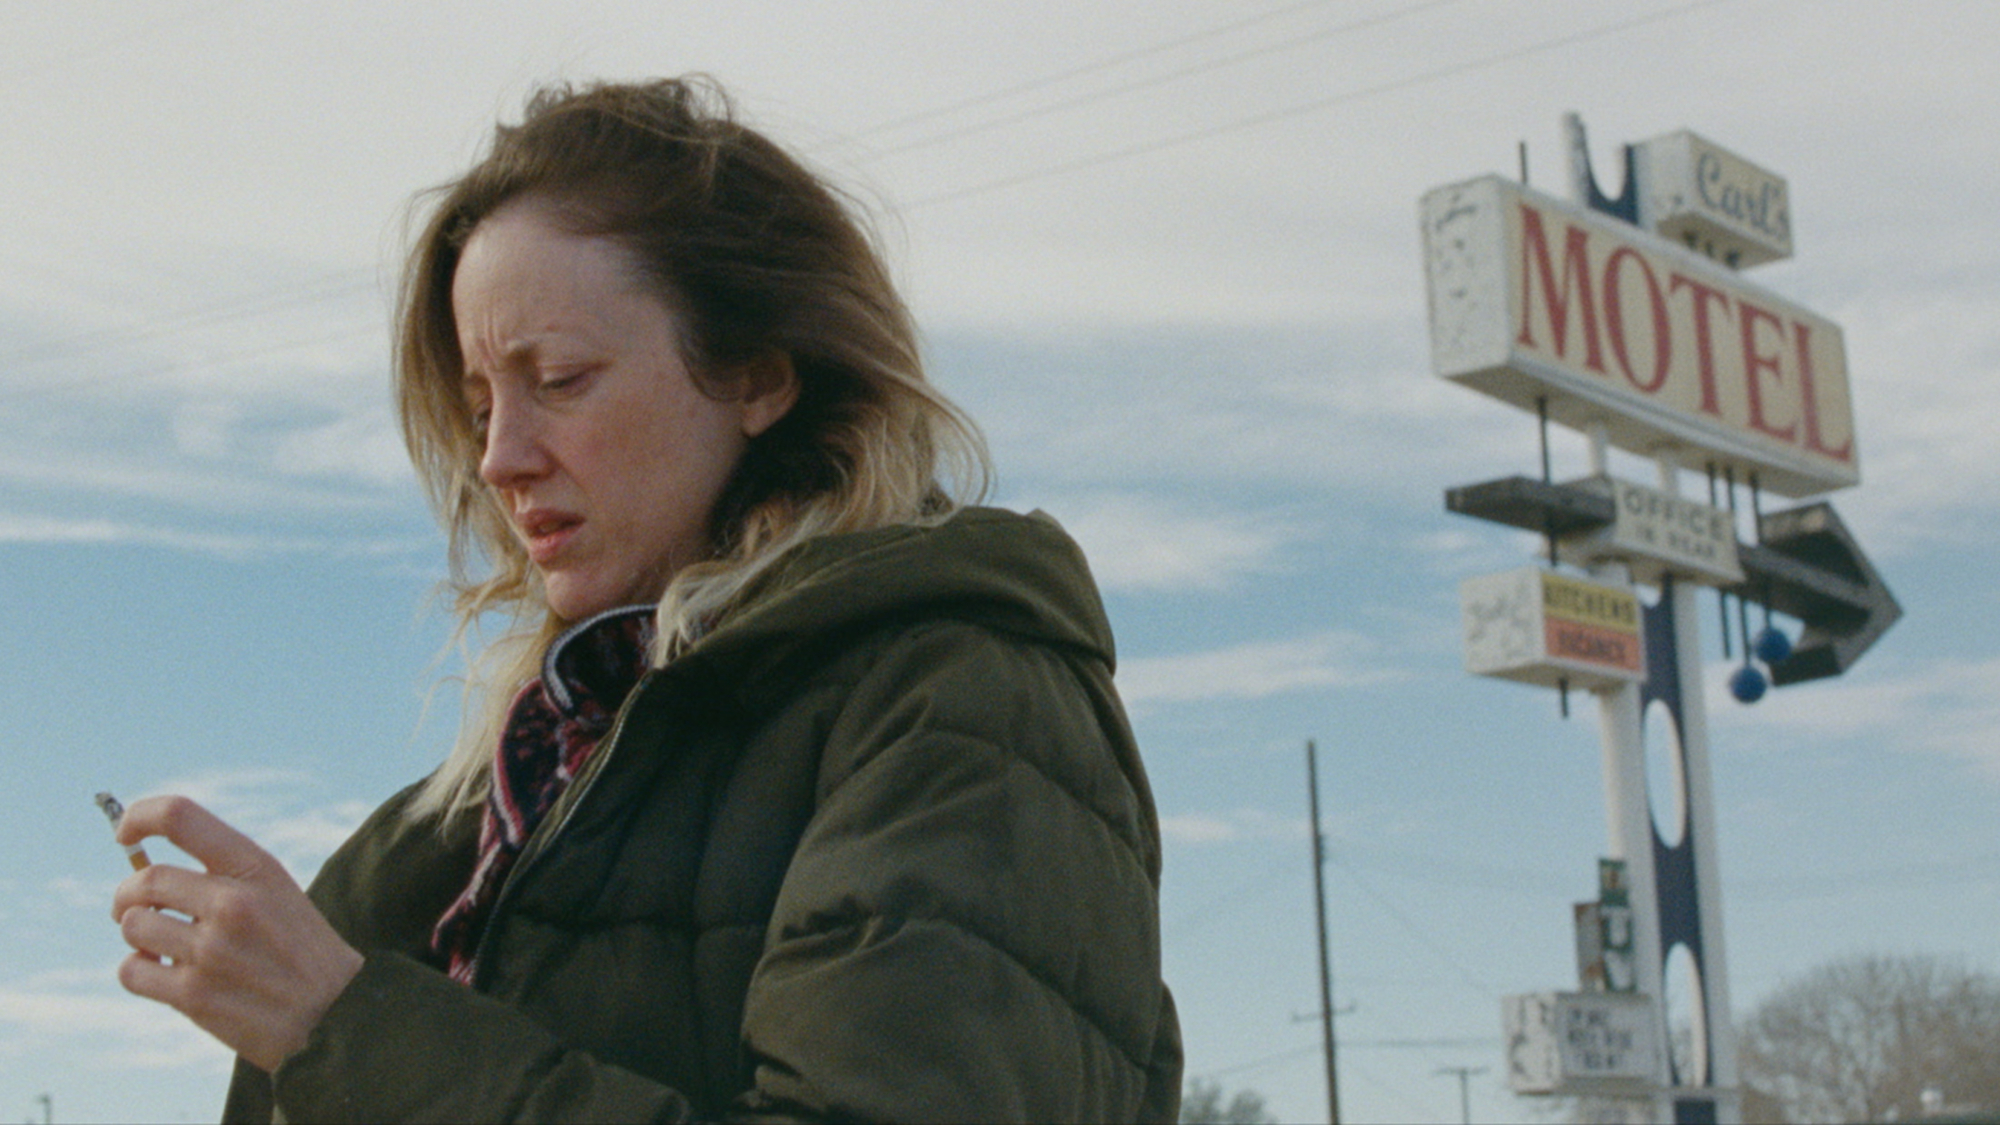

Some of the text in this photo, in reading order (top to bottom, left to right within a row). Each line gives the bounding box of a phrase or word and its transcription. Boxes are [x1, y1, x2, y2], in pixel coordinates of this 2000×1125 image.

[1517, 203, 1852, 462] MOTEL
[1624, 487, 1723, 541] OFFICE
[1544, 581, 1635, 625] KITCHENS
